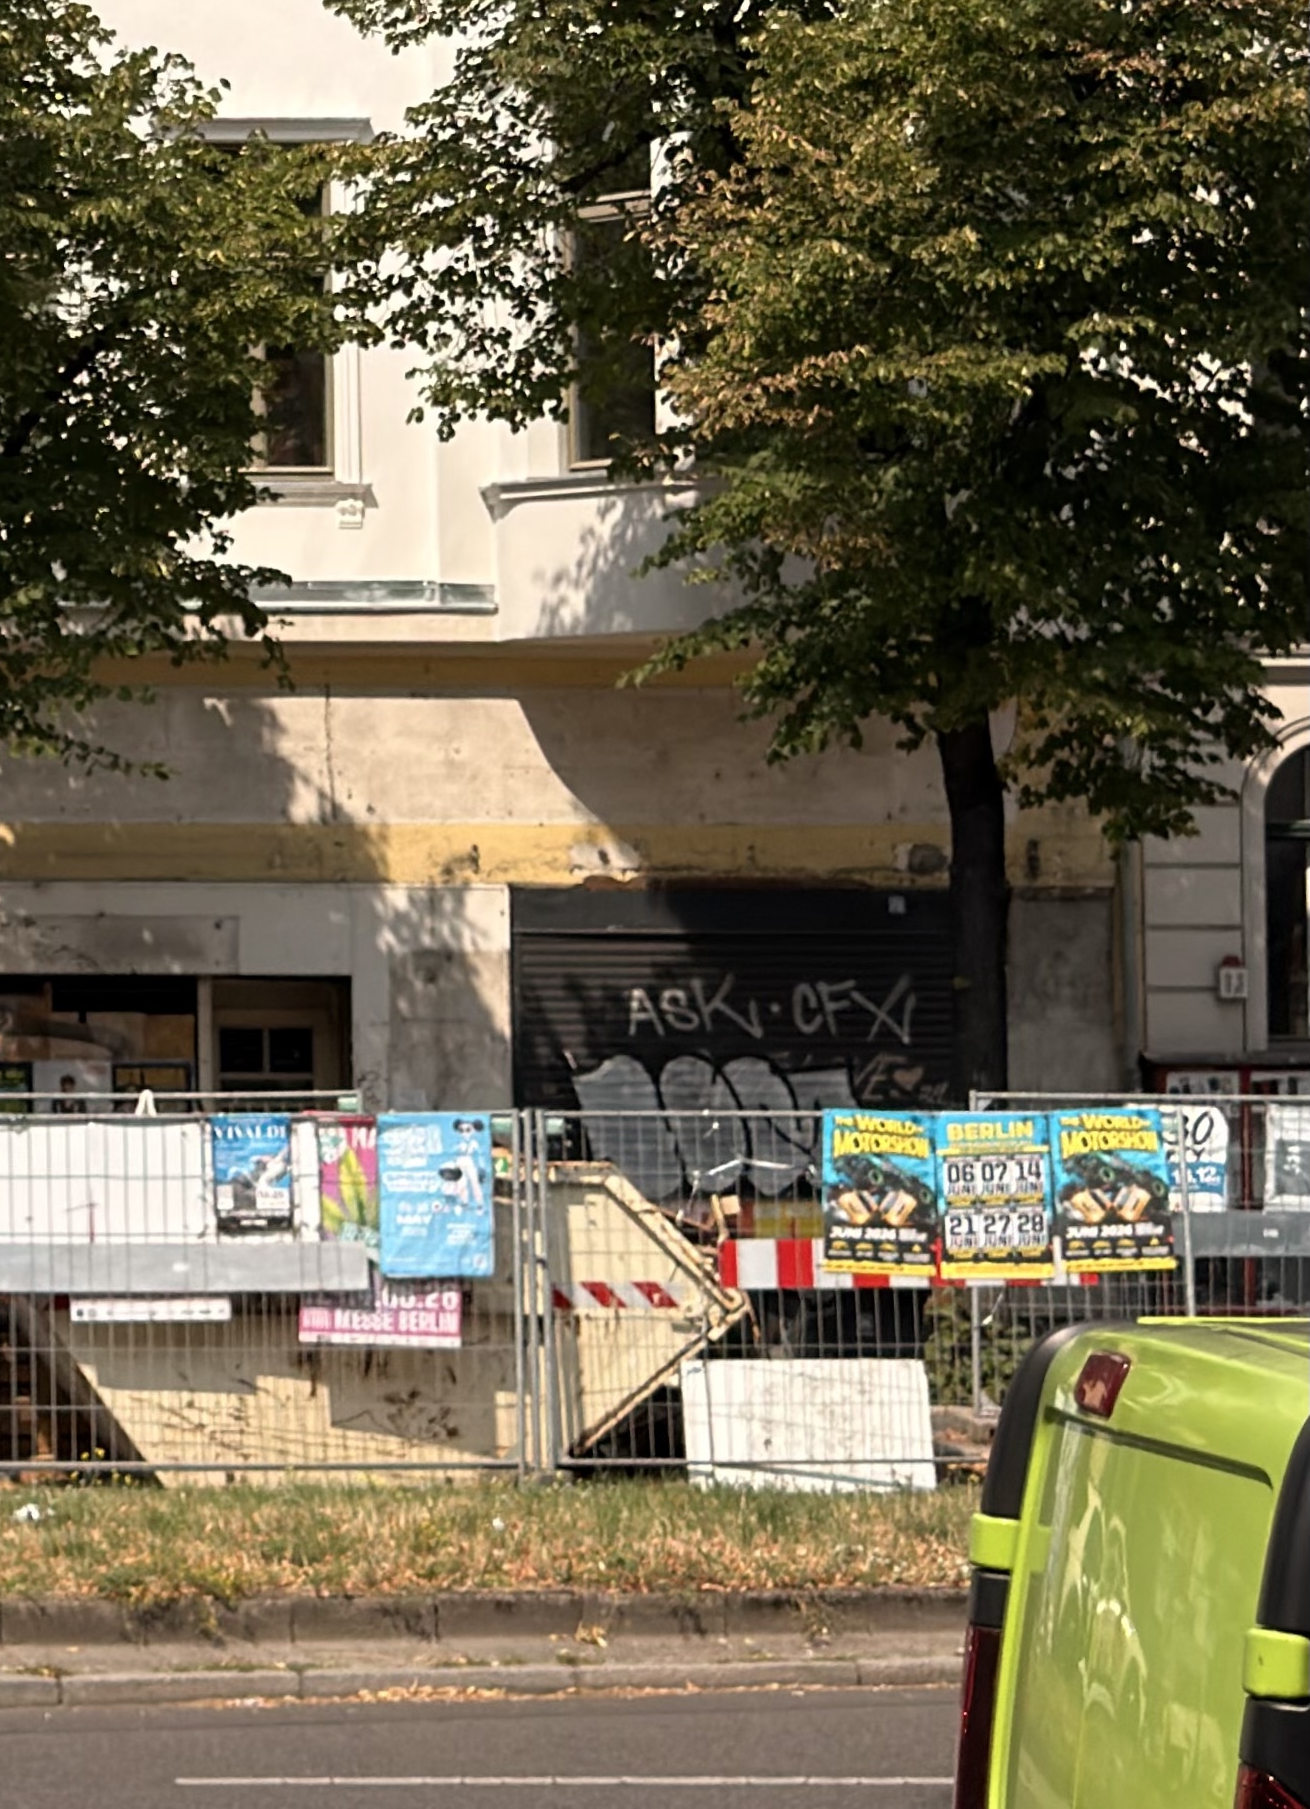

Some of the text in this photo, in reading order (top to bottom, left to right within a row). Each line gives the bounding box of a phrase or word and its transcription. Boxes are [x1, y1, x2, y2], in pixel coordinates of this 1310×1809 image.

[214, 1125, 288, 1140] VIVALDI
[855, 1114, 916, 1135] WORLD
[946, 1121, 1034, 1141] BERLIN
[834, 1130, 929, 1158] MOTORSHOW
[1061, 1130, 1158, 1159] MOTORSHOW
[947, 1162, 1042, 1183] 06 07 14
[949, 1215, 976, 1236] 21
[983, 1214, 1011, 1234] 27
[1017, 1214, 1044, 1233] 28
[398, 1310, 459, 1334] BERLIN
